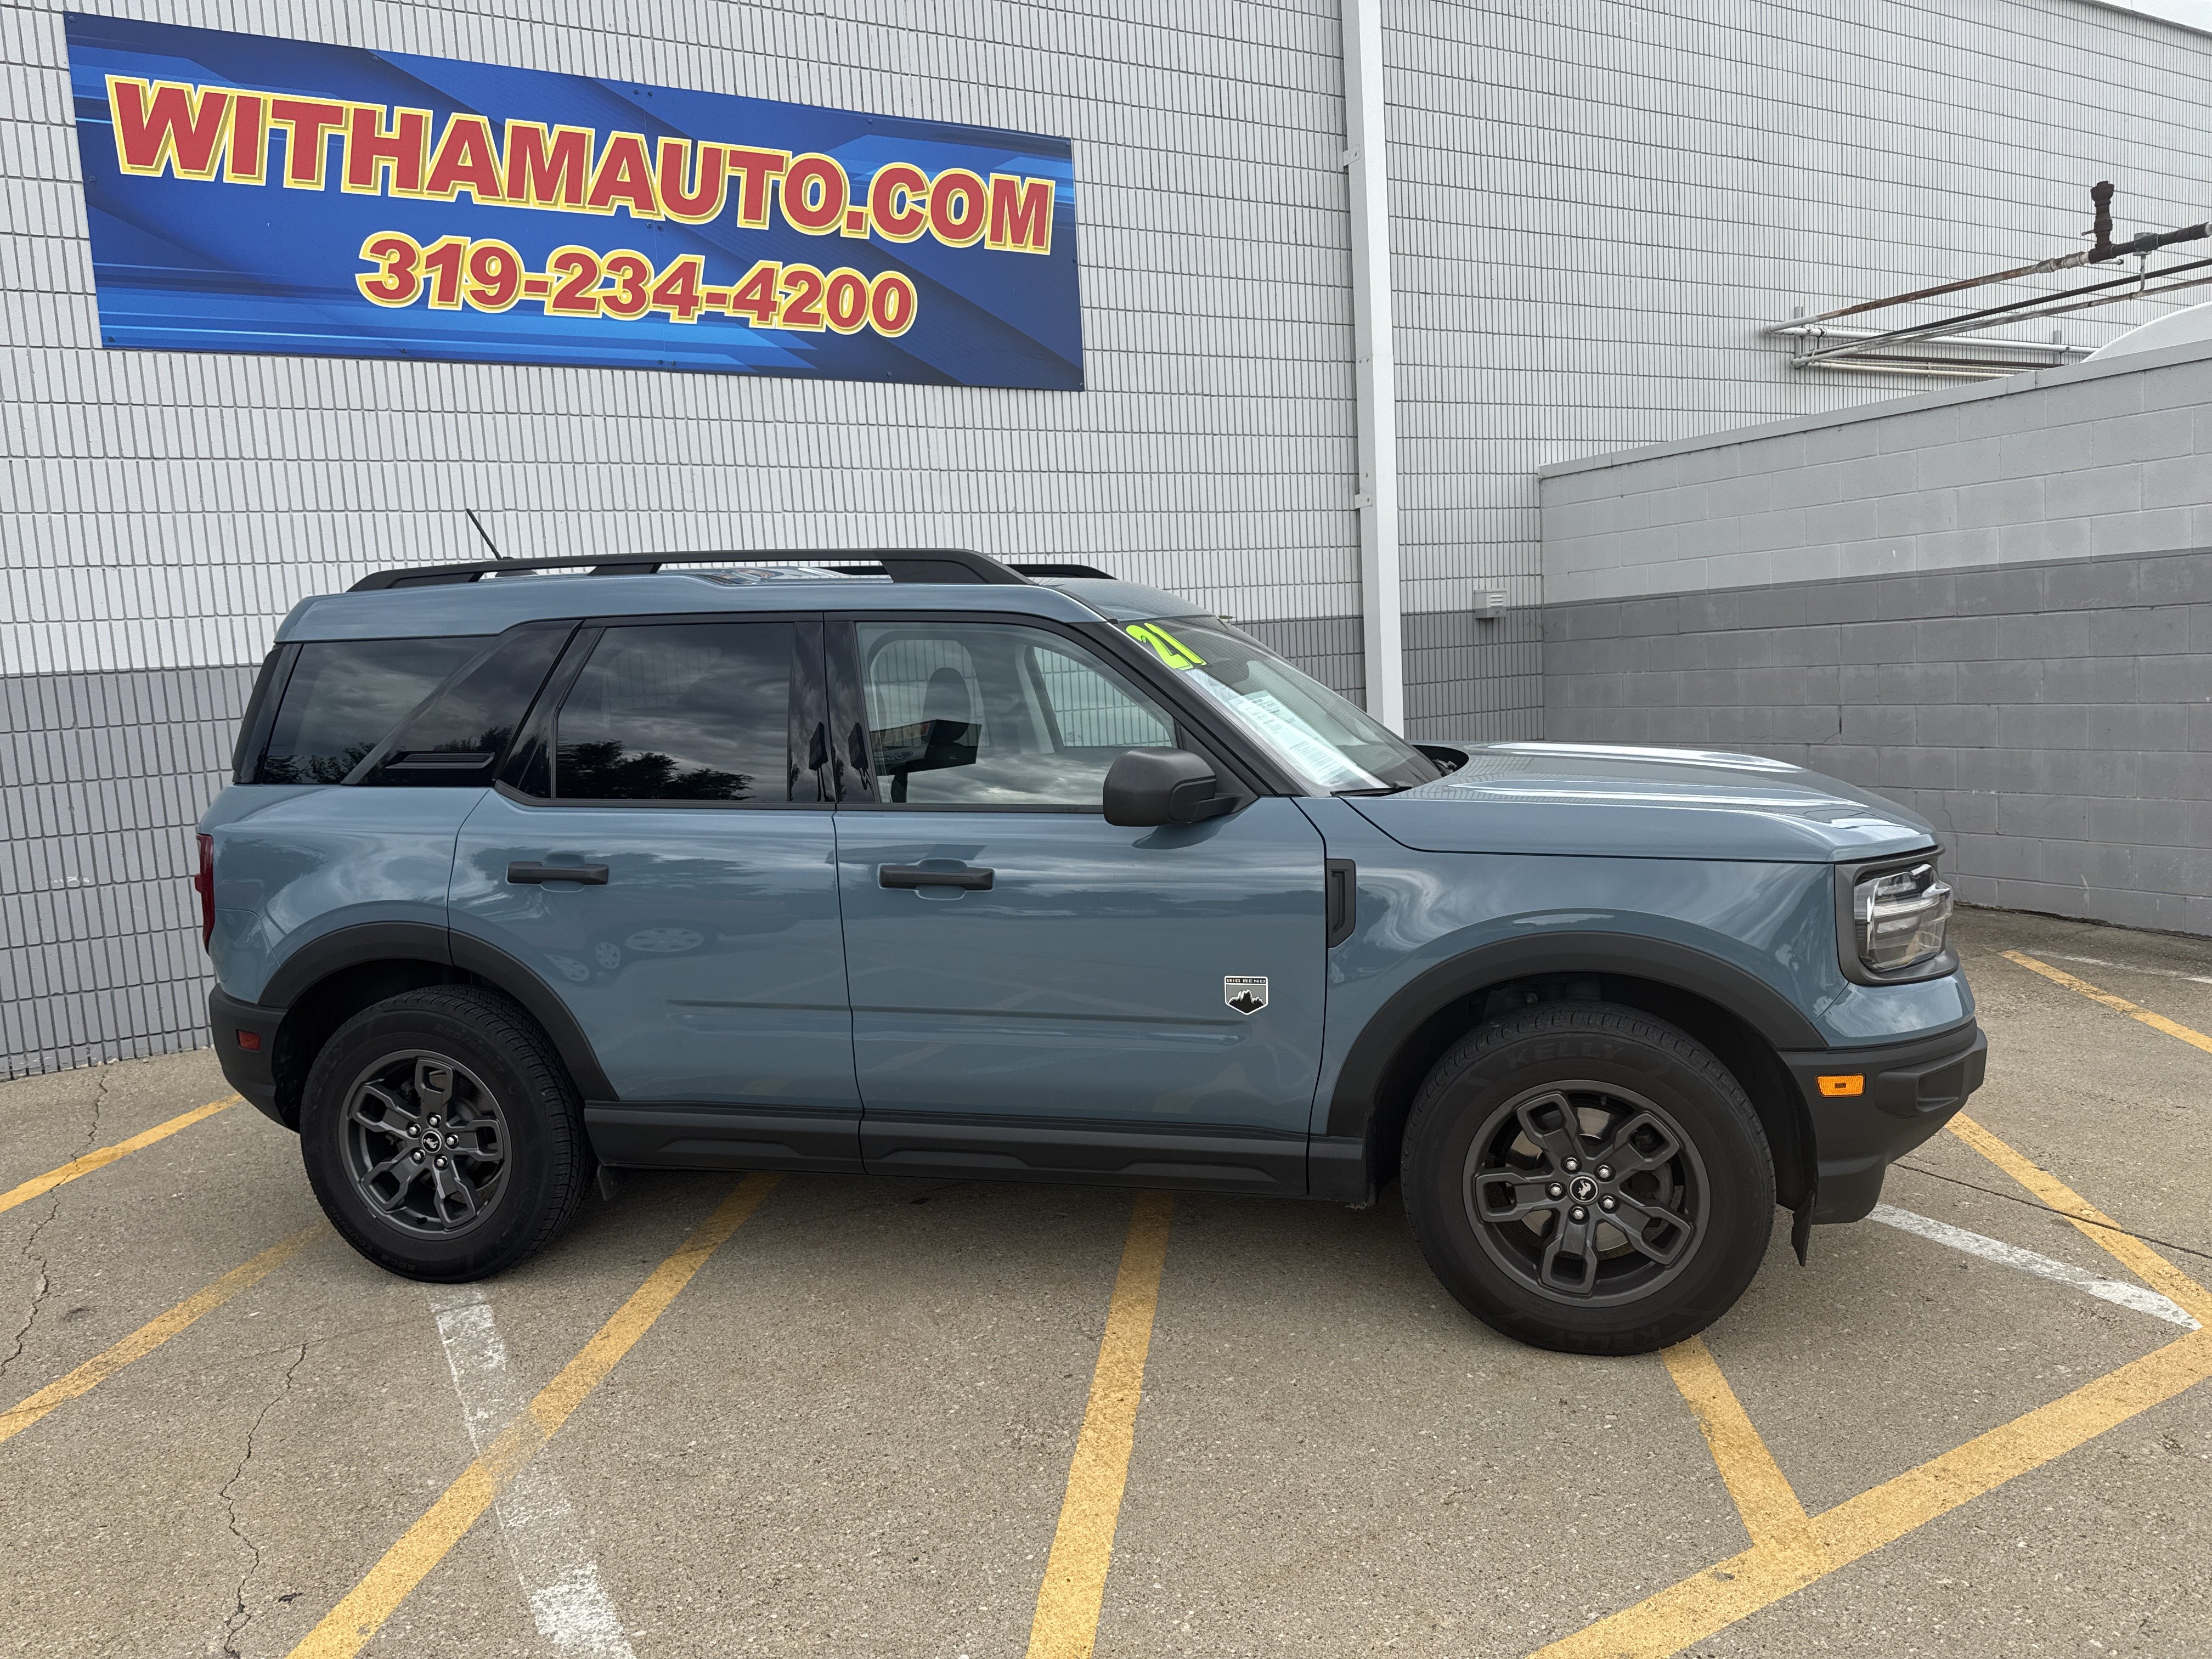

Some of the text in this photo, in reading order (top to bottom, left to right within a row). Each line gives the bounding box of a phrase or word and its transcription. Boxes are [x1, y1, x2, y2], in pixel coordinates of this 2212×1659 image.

[105, 74, 1056, 256] WITHAMAUTO.COM
[355, 230, 917, 337] 319-234-4200
[1126, 623, 1207, 670] 21
[1506, 1040, 1626, 1071] KELLY
